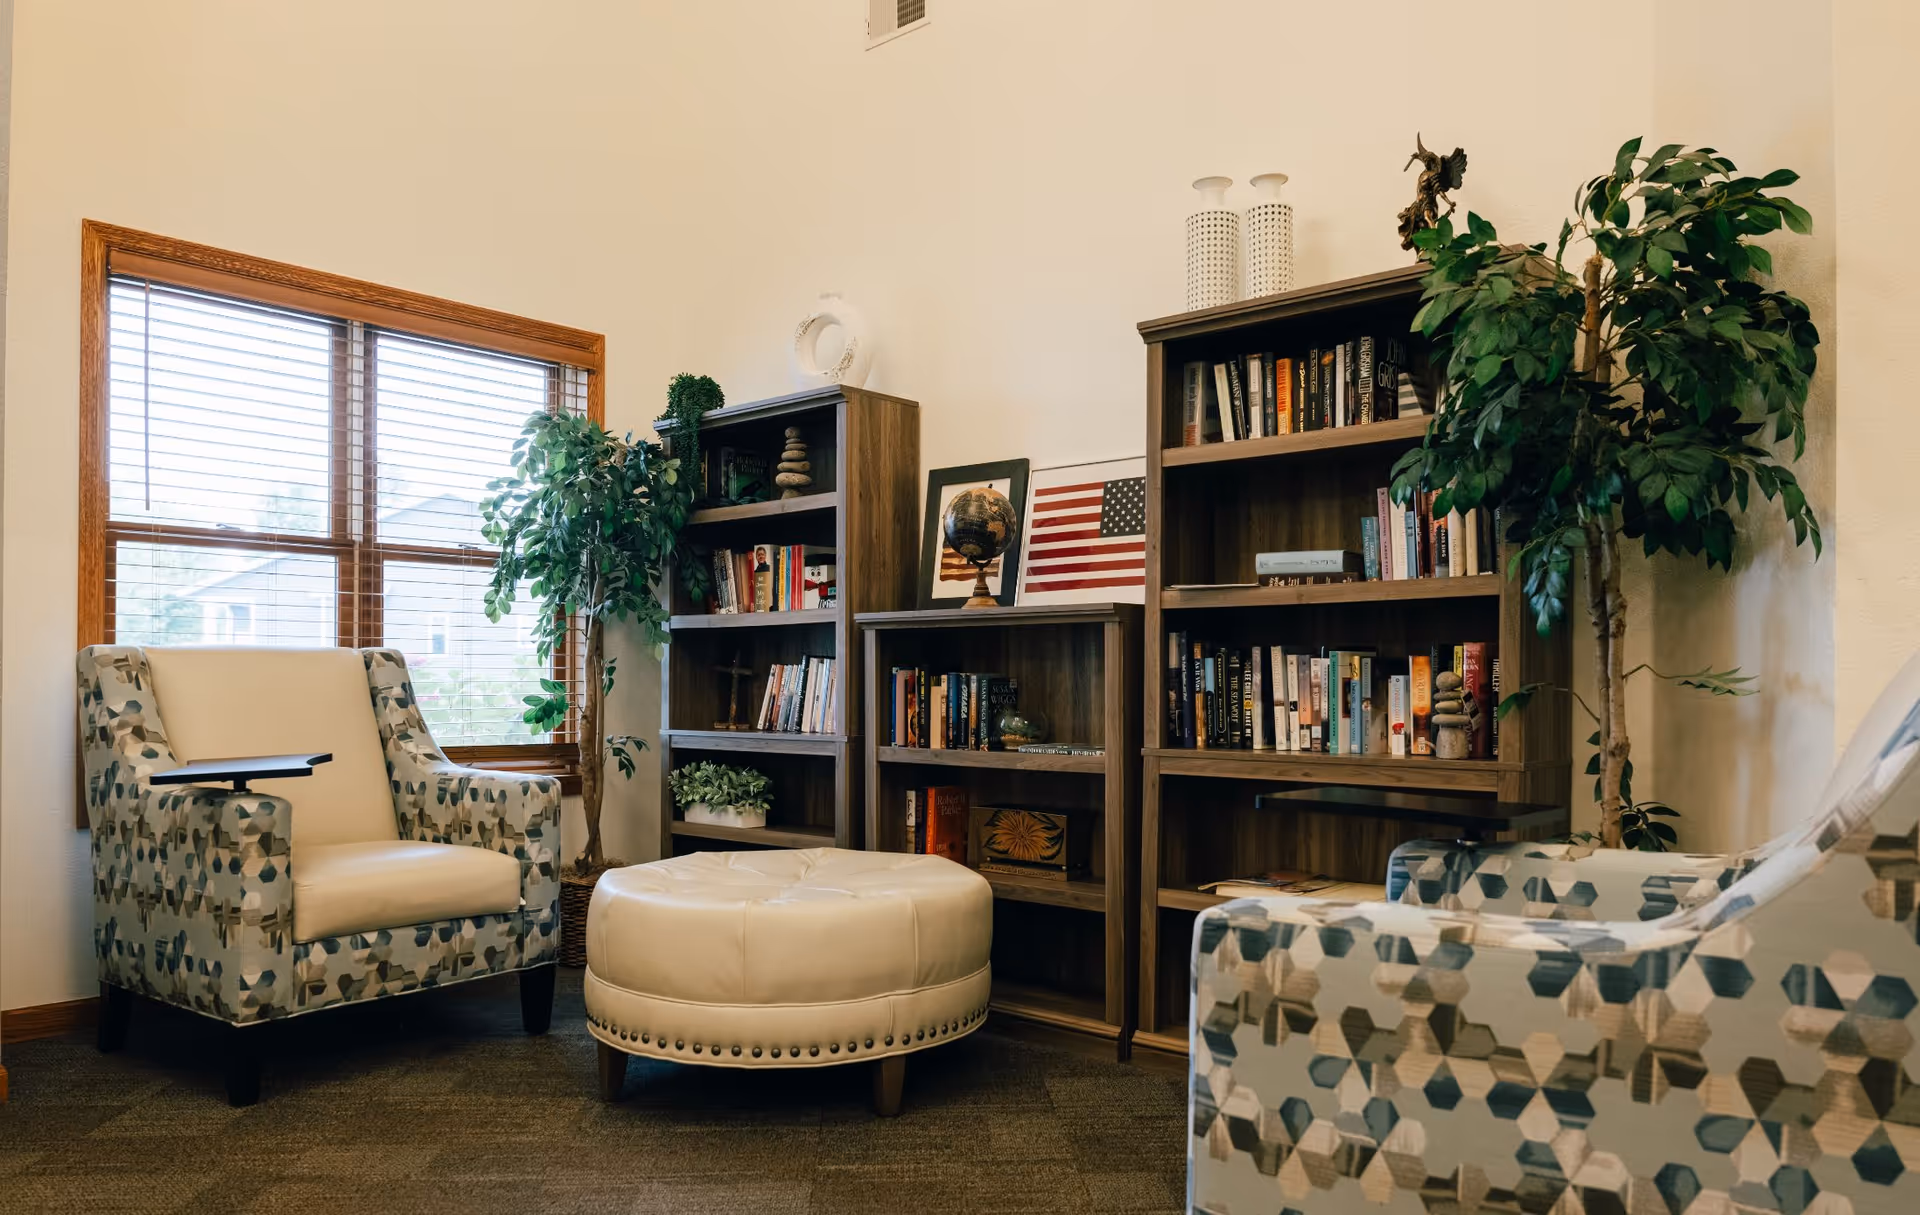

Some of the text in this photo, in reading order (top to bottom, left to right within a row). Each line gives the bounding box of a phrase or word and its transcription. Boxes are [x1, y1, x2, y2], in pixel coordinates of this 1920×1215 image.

[1360, 352, 1372, 378] GRISHAM
[992, 685, 1014, 693] SUSAN
[1244, 670, 1252, 699] LEE CHILD
[1492, 658, 1501, 692] THRILLER
[991, 695, 1016, 704] WIGGS
[1230, 676, 1239, 723] THE SEA WOLF
[1244, 710, 1252, 738] MAKE ME
